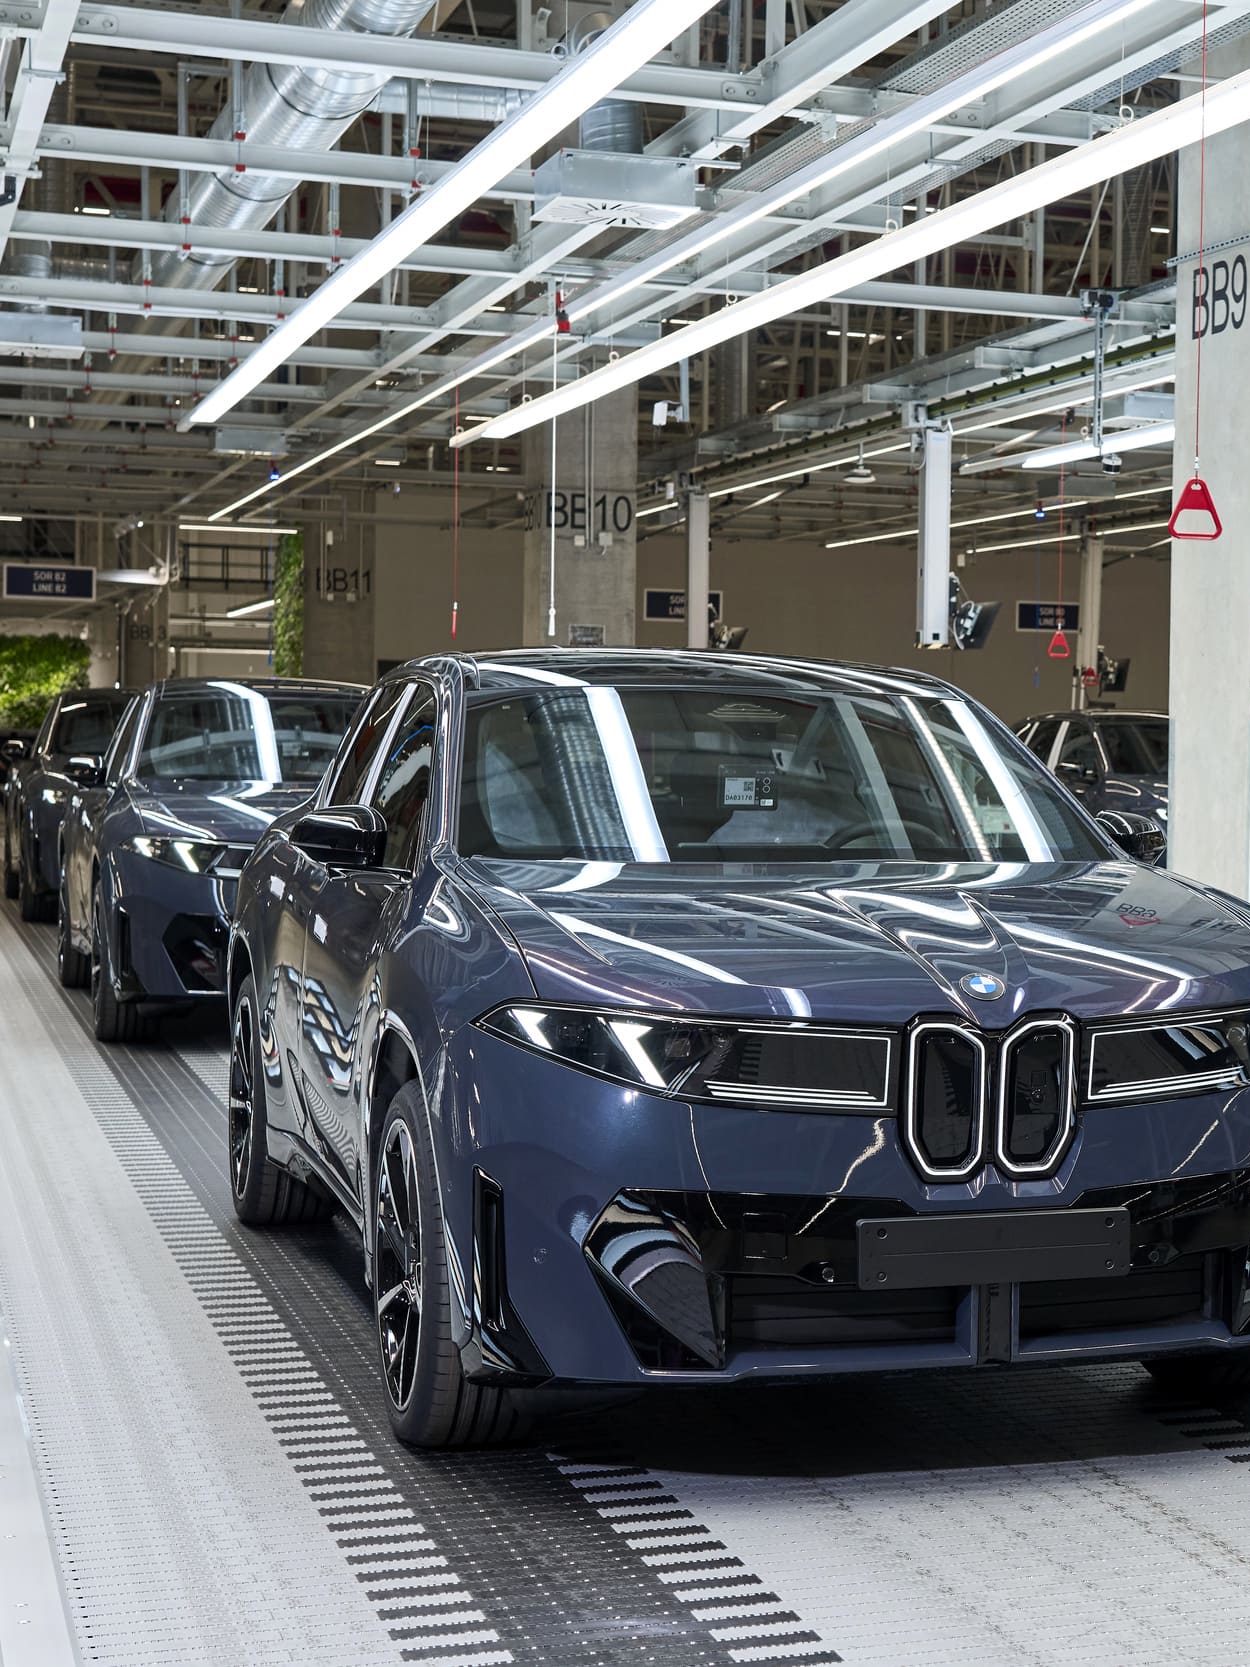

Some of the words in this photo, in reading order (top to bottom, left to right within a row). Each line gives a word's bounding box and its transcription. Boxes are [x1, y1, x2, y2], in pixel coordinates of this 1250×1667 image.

[1191, 254, 1248, 340] BB9
[33, 571, 53, 581] SOR
[32, 583, 53, 593] LINE
